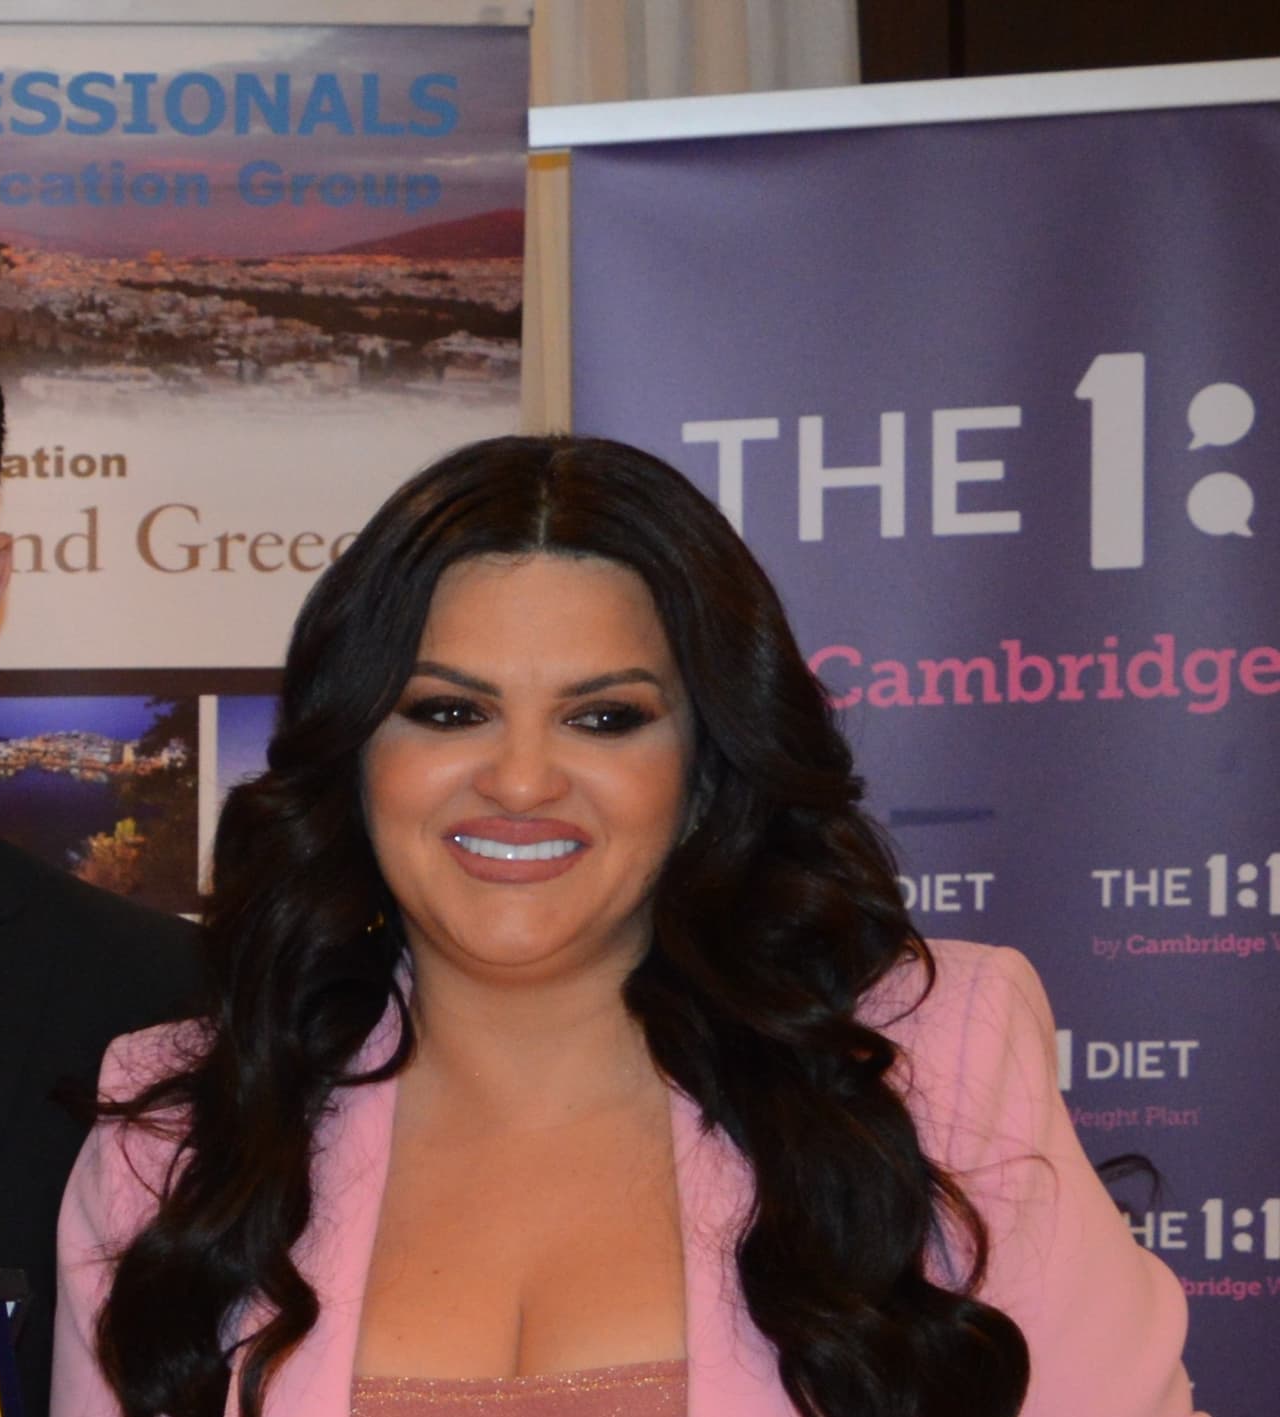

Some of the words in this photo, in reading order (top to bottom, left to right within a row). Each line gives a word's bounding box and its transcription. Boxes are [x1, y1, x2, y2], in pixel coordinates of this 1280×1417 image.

[239, 160, 443, 213] Group
[682, 405, 1022, 541] THE
[807, 633, 1280, 714] Cambridge
[1091, 867, 1192, 908] THE
[1092, 935, 1122, 957] by
[1126, 932, 1266, 956] Cambridge
[1086, 1040, 1200, 1080] DIET
[1201, 1197, 1280, 1260] 1:1
